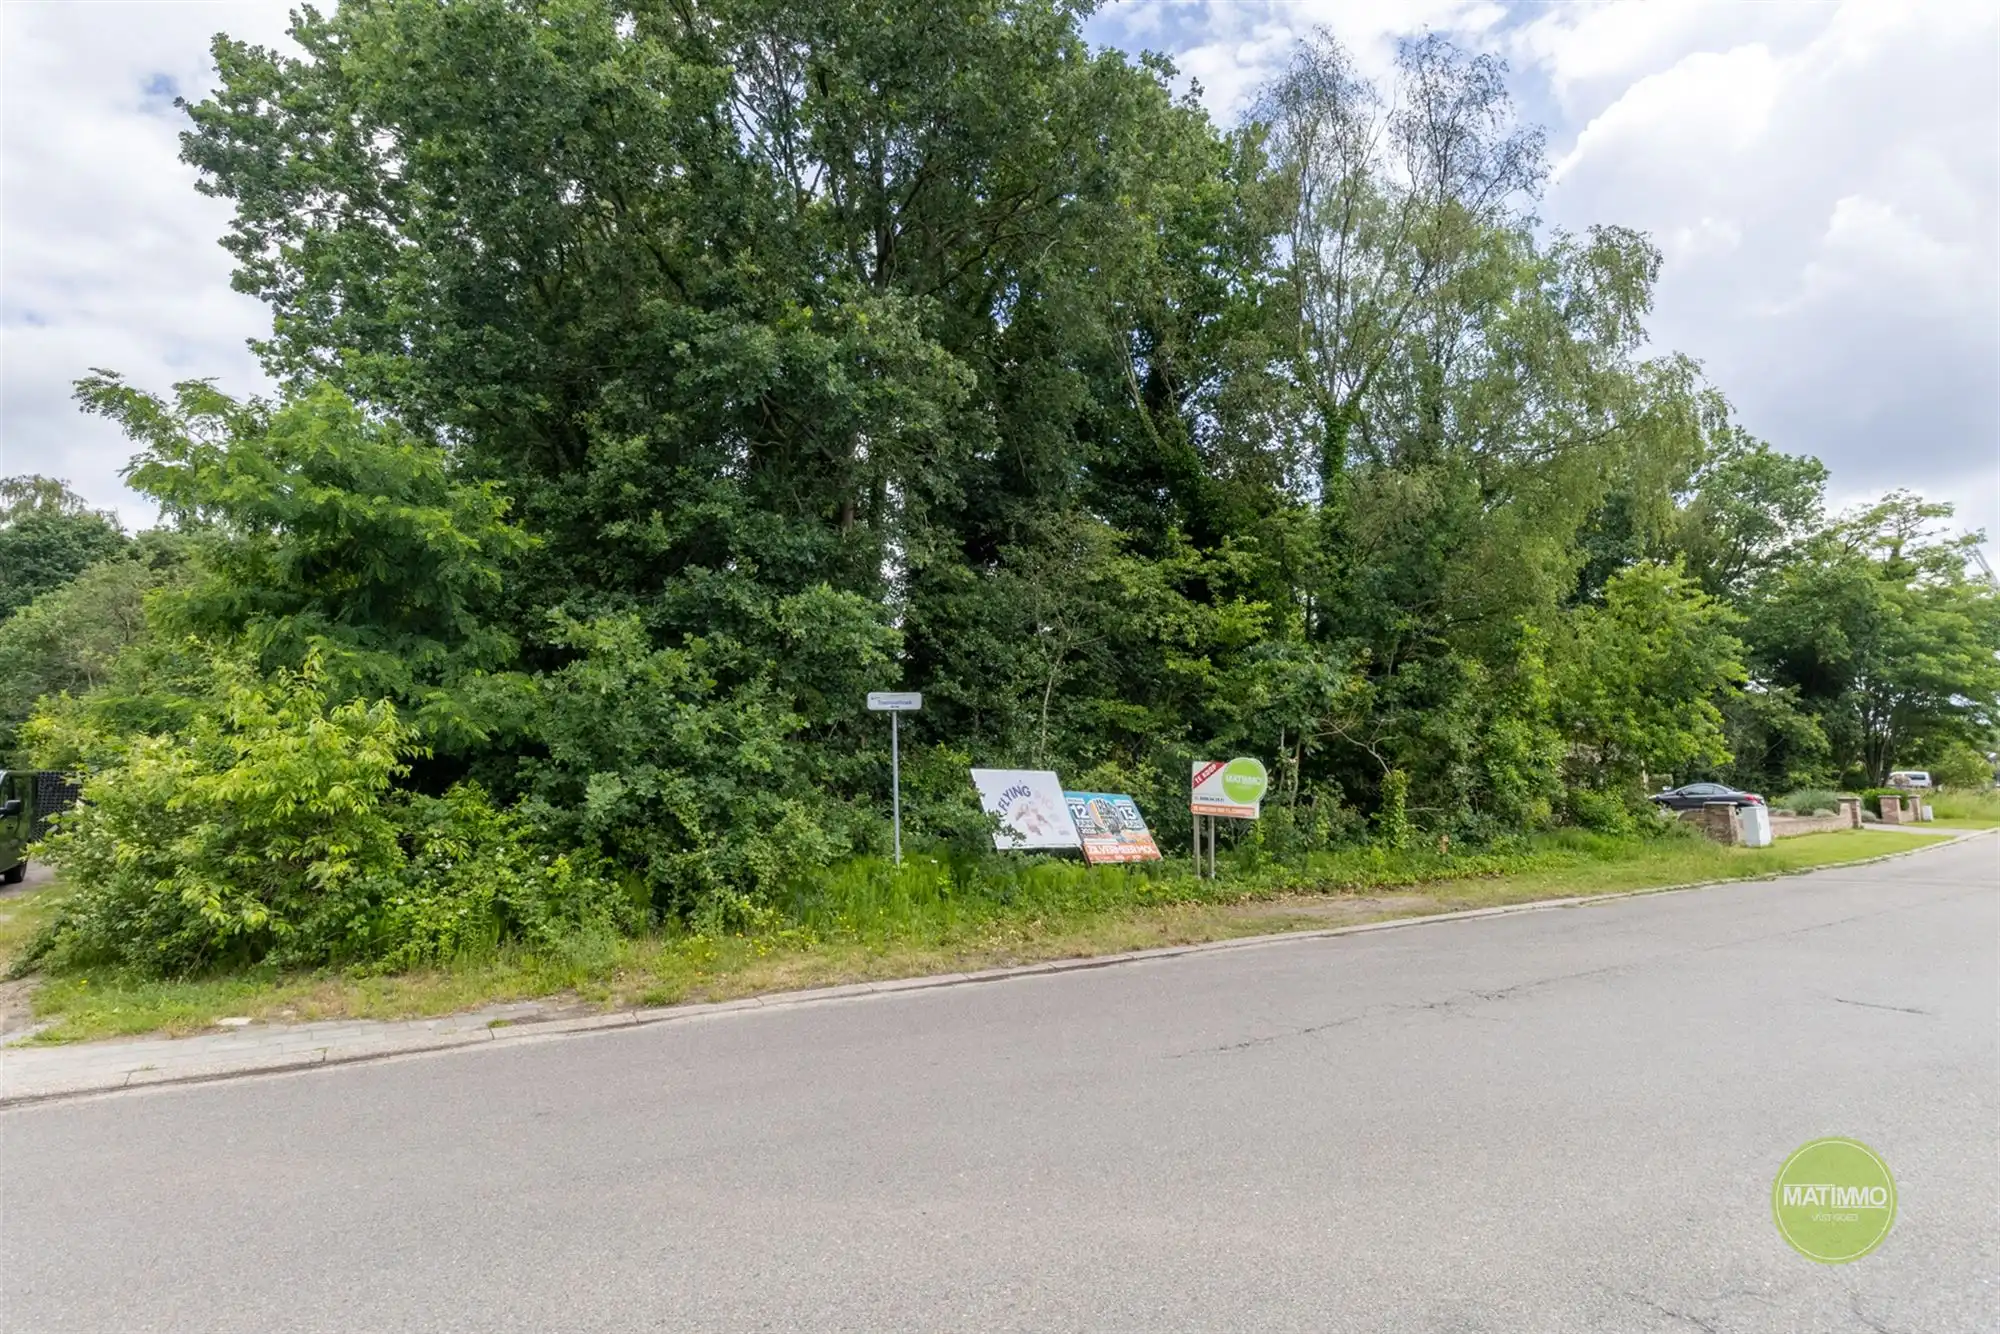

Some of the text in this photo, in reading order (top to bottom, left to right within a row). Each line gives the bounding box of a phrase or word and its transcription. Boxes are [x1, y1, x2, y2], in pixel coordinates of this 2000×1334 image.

[998, 785, 1031, 812] FLYING
[1070, 804, 1090, 818] 12
[1119, 806, 1137, 820] 13
